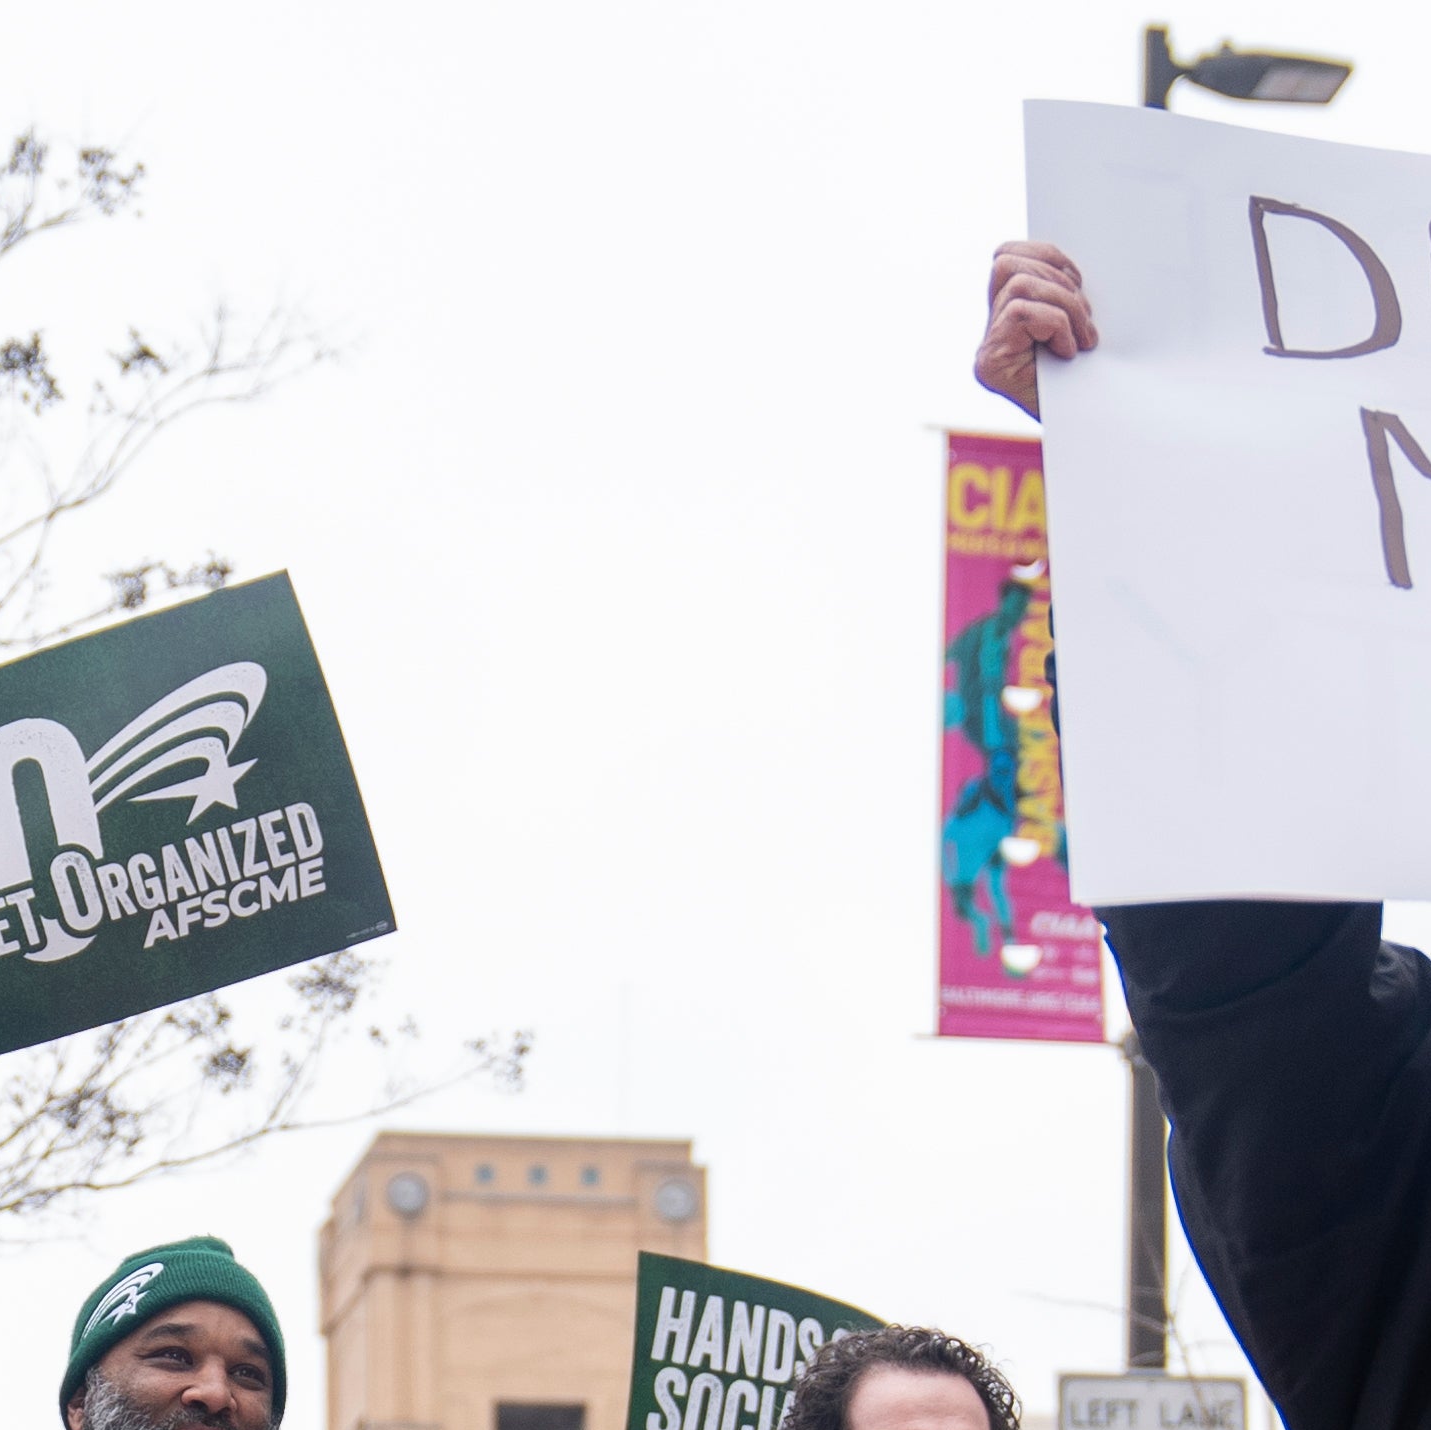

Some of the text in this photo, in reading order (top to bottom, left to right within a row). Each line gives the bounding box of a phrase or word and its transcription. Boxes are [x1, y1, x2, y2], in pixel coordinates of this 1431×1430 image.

[50, 801, 325, 933] ORGANIZED
[142, 857, 327, 950] AFSCME
[1069, 1398, 1237, 1430] LEFT LANE
